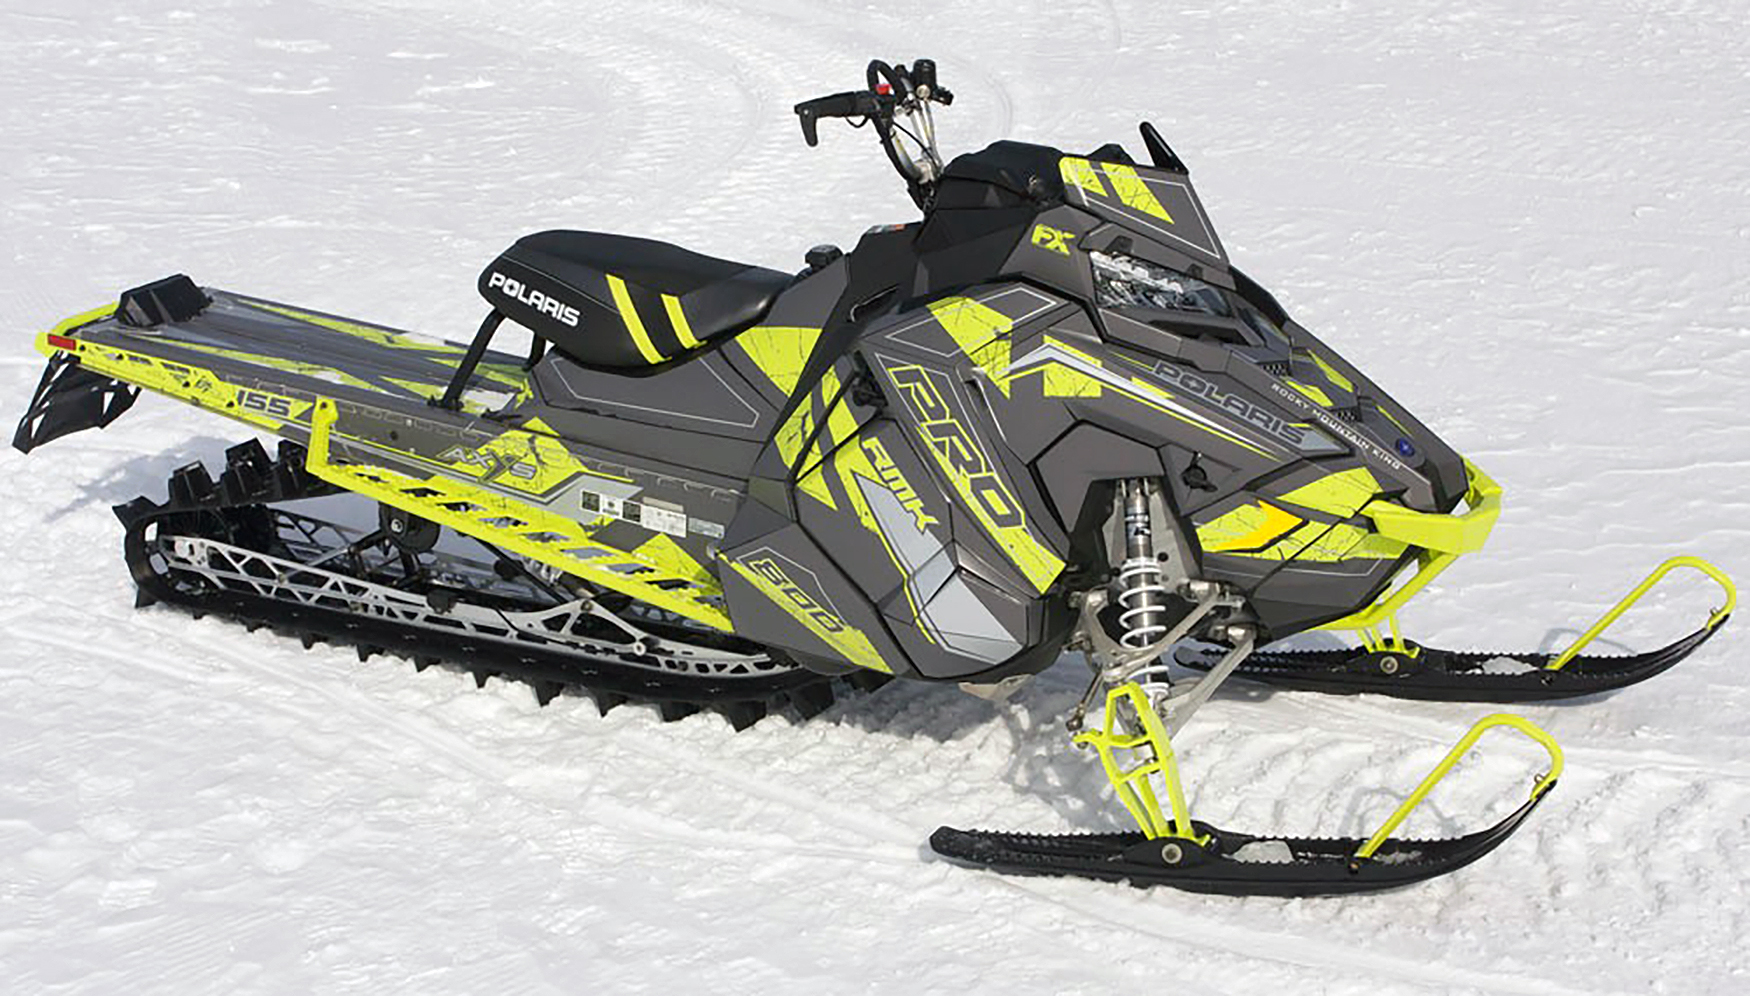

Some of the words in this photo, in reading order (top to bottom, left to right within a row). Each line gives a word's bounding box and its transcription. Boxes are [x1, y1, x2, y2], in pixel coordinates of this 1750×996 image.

[1031, 223, 1077, 255] FX
[488, 272, 581, 328] POLARIS
[236, 389, 291, 417] 155
[1153, 359, 1306, 446] POLARIS
[1271, 382, 1310, 409] ROCKY
[1312, 408, 1371, 451] MOUNTAIN
[1371, 448, 1401, 471] KING
[861, 436, 940, 533] RMK
[886, 364, 1028, 530] PRO
[748, 558, 845, 633] 800
